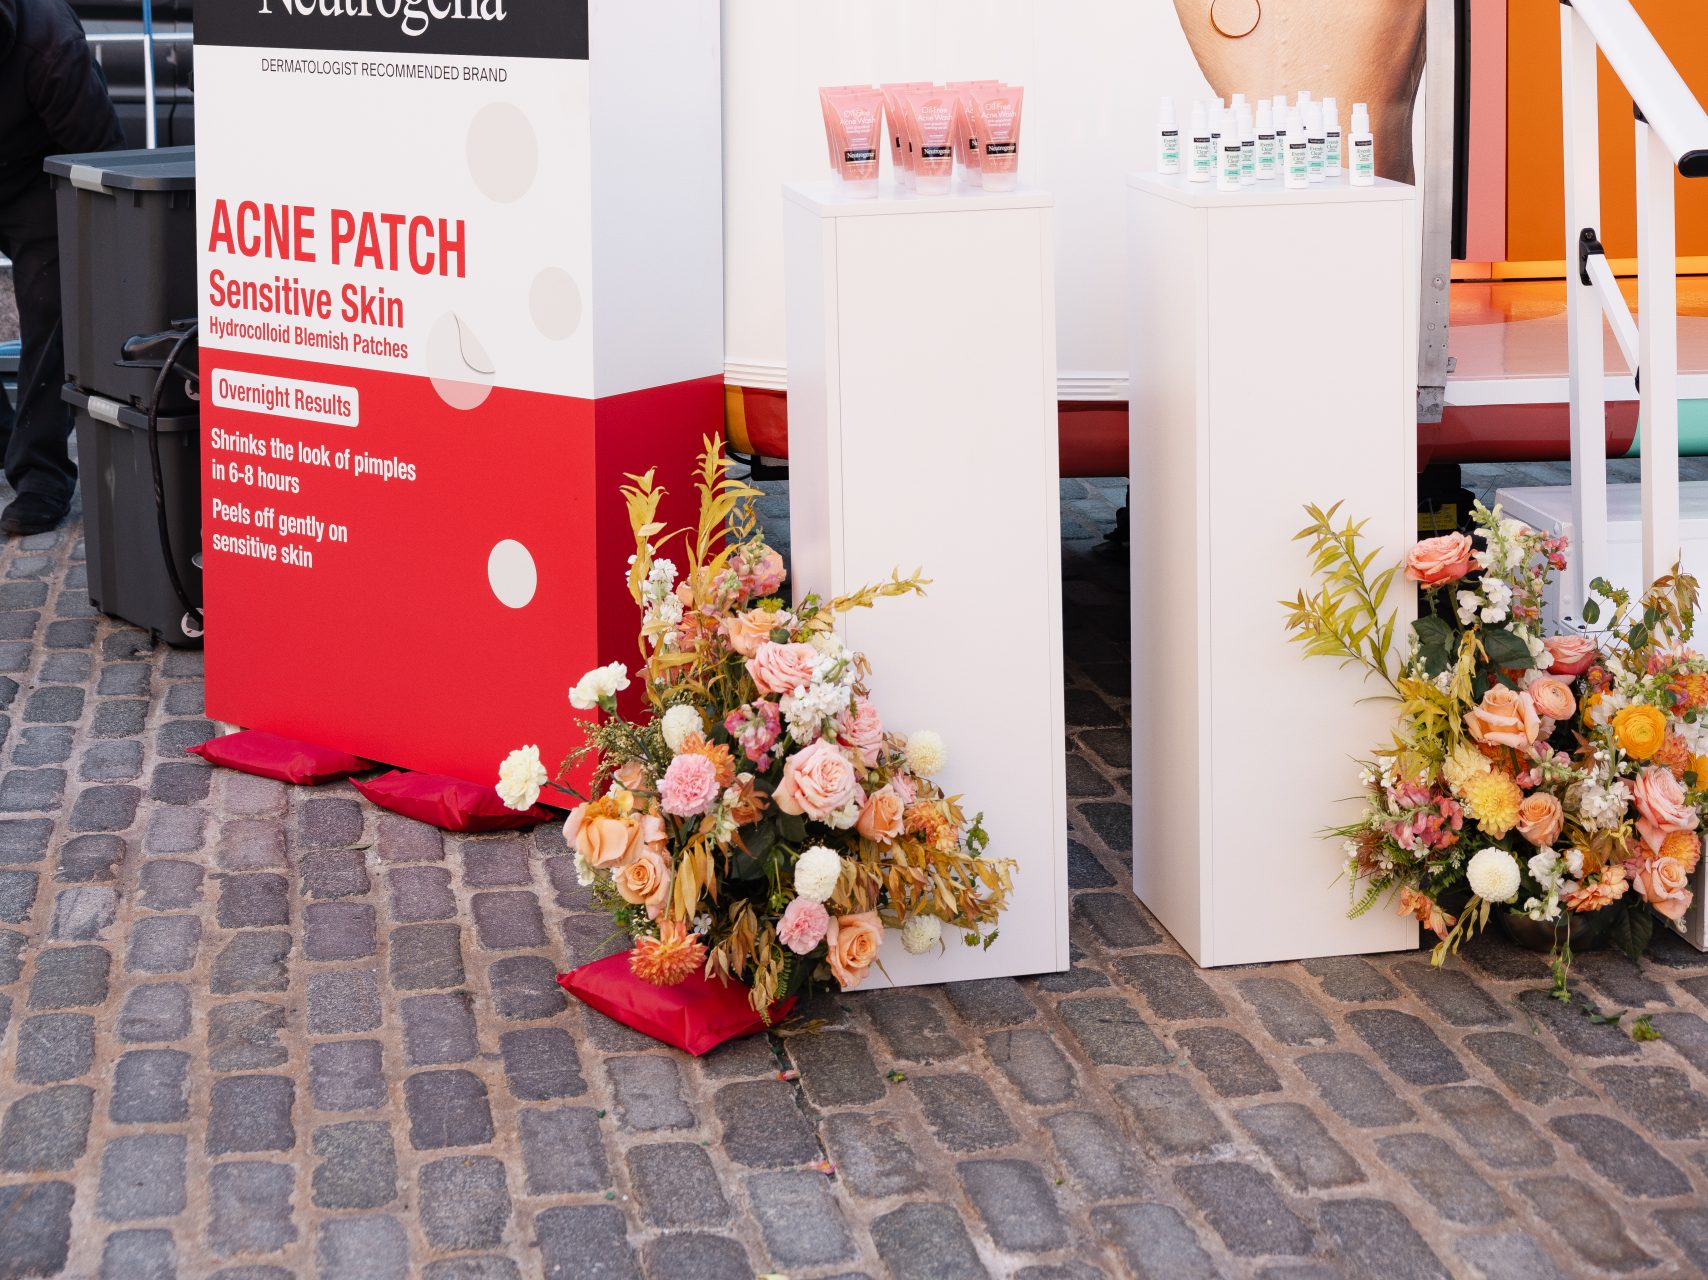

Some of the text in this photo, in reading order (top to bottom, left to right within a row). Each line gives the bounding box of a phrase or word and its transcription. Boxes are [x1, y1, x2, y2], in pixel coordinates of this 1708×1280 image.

[261, 58, 508, 83] DERMATOLOGIST RECOMMENDED BRAND
[208, 198, 466, 279] ACNE PATCH
[209, 268, 404, 329] Sensitive Skin
[209, 315, 408, 359] Hydrocolloid Blemish Patches
[219, 378, 351, 418] Overnight Results
[211, 427, 417, 482] Shrinks the look of pimples
[211, 459, 300, 494] in 6-8 hours
[212, 498, 348, 543] Peels off gently on
[212, 532, 313, 569] sensitive skin
